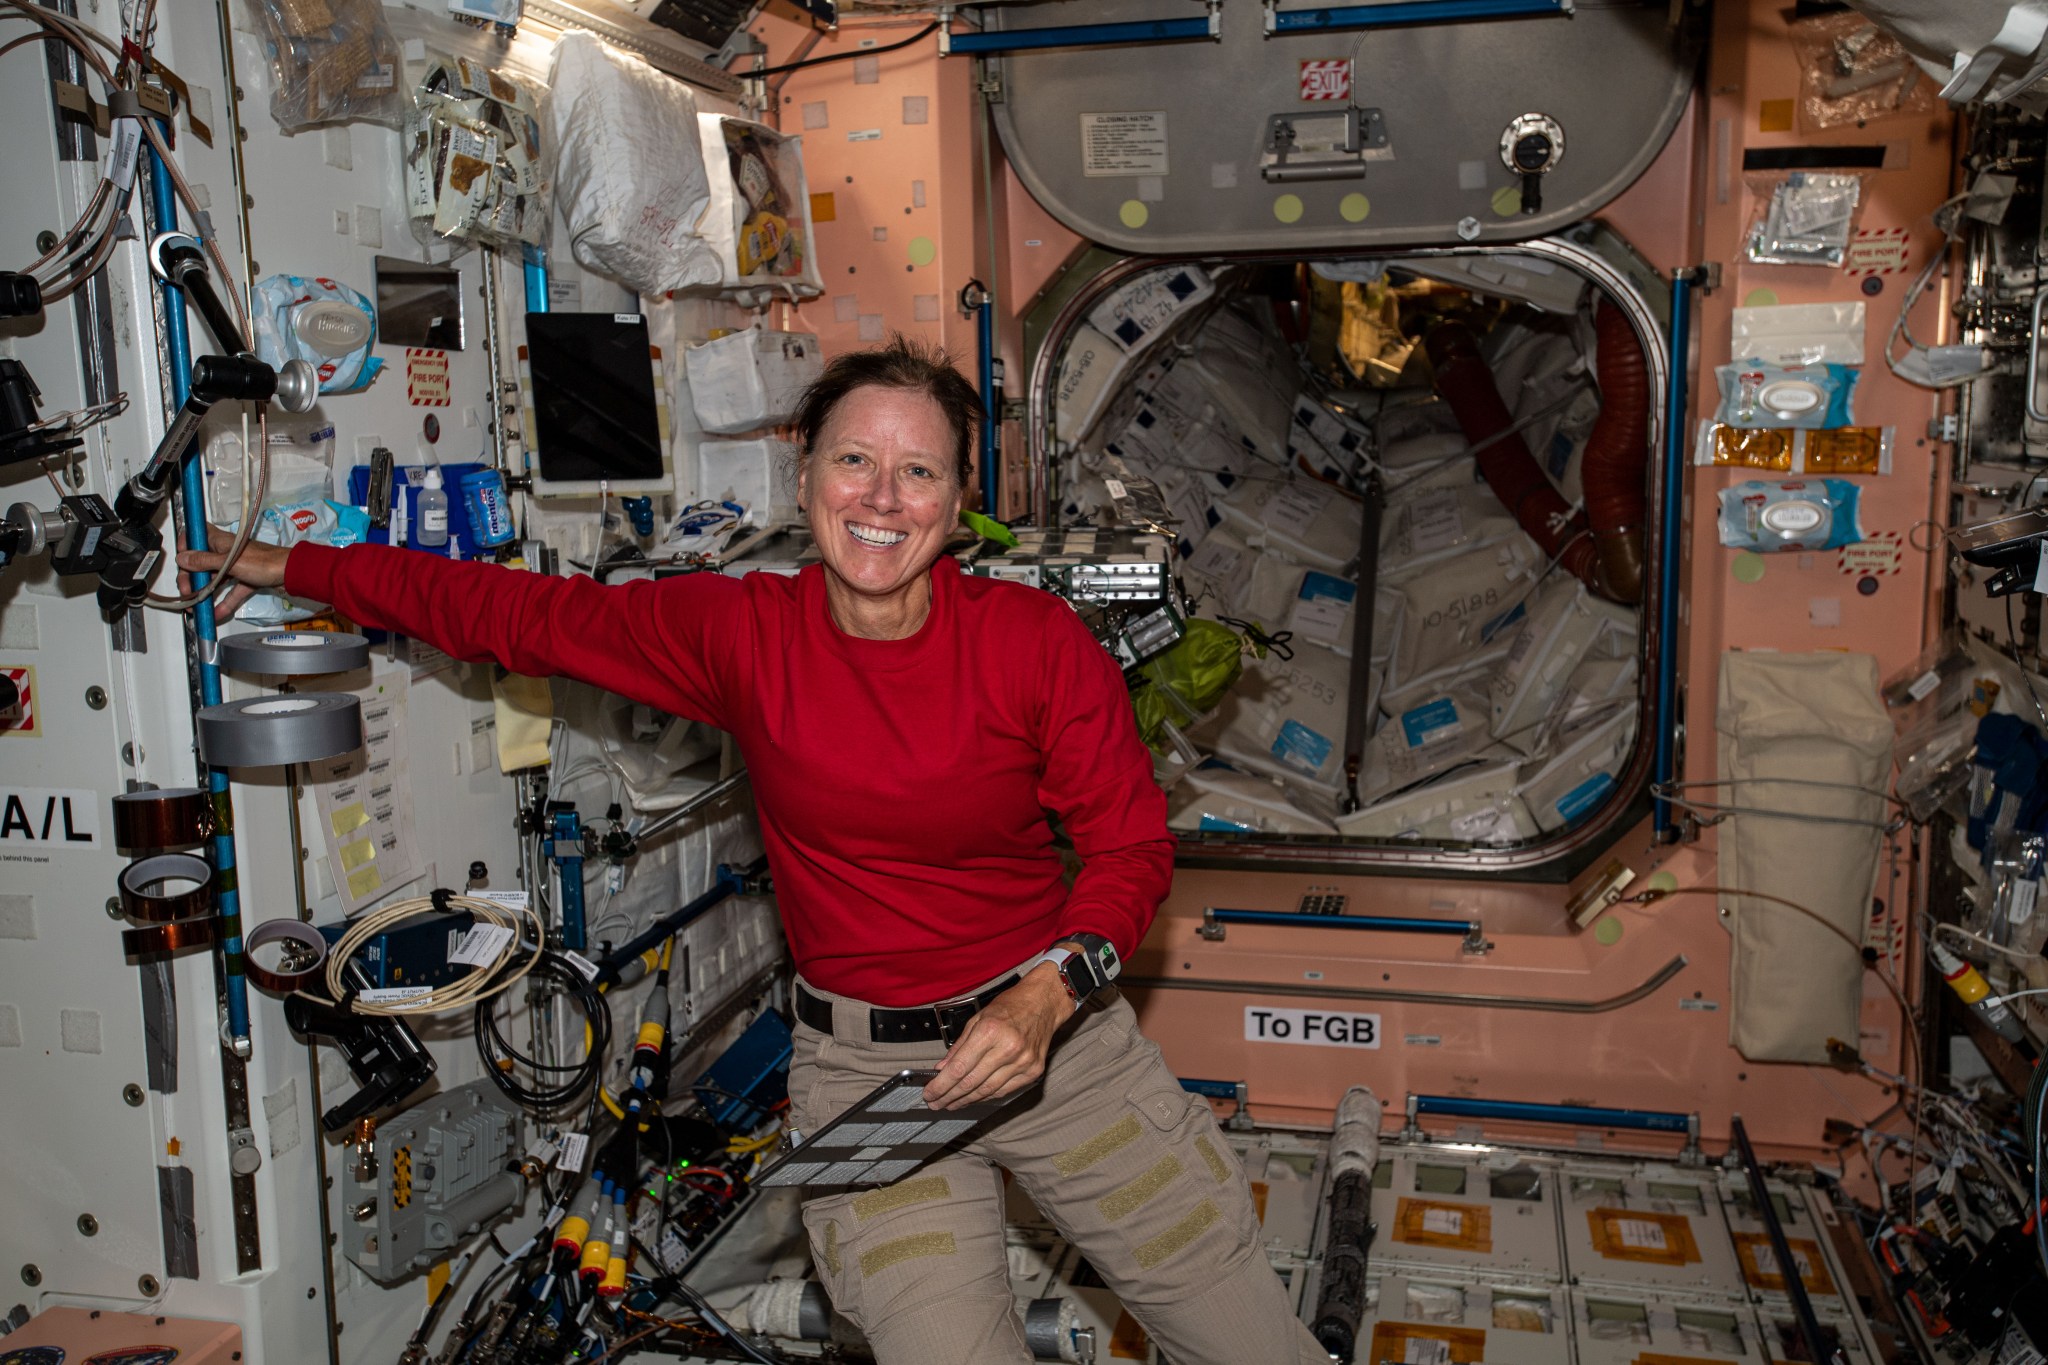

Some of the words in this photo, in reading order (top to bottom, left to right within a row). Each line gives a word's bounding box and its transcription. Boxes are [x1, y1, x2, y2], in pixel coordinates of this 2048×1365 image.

[1308, 70, 1341, 91] EXIT
[1852, 249, 1873, 257] FIRE
[1875, 247, 1898, 255] PORT
[413, 373, 428, 383] FIRE
[428, 374, 445, 385] PORT
[486, 488, 499, 535] mentos
[3, 854, 21, 862] behind
[1250, 1011, 1292, 1038] To
[1303, 1015, 1375, 1044] FGB
